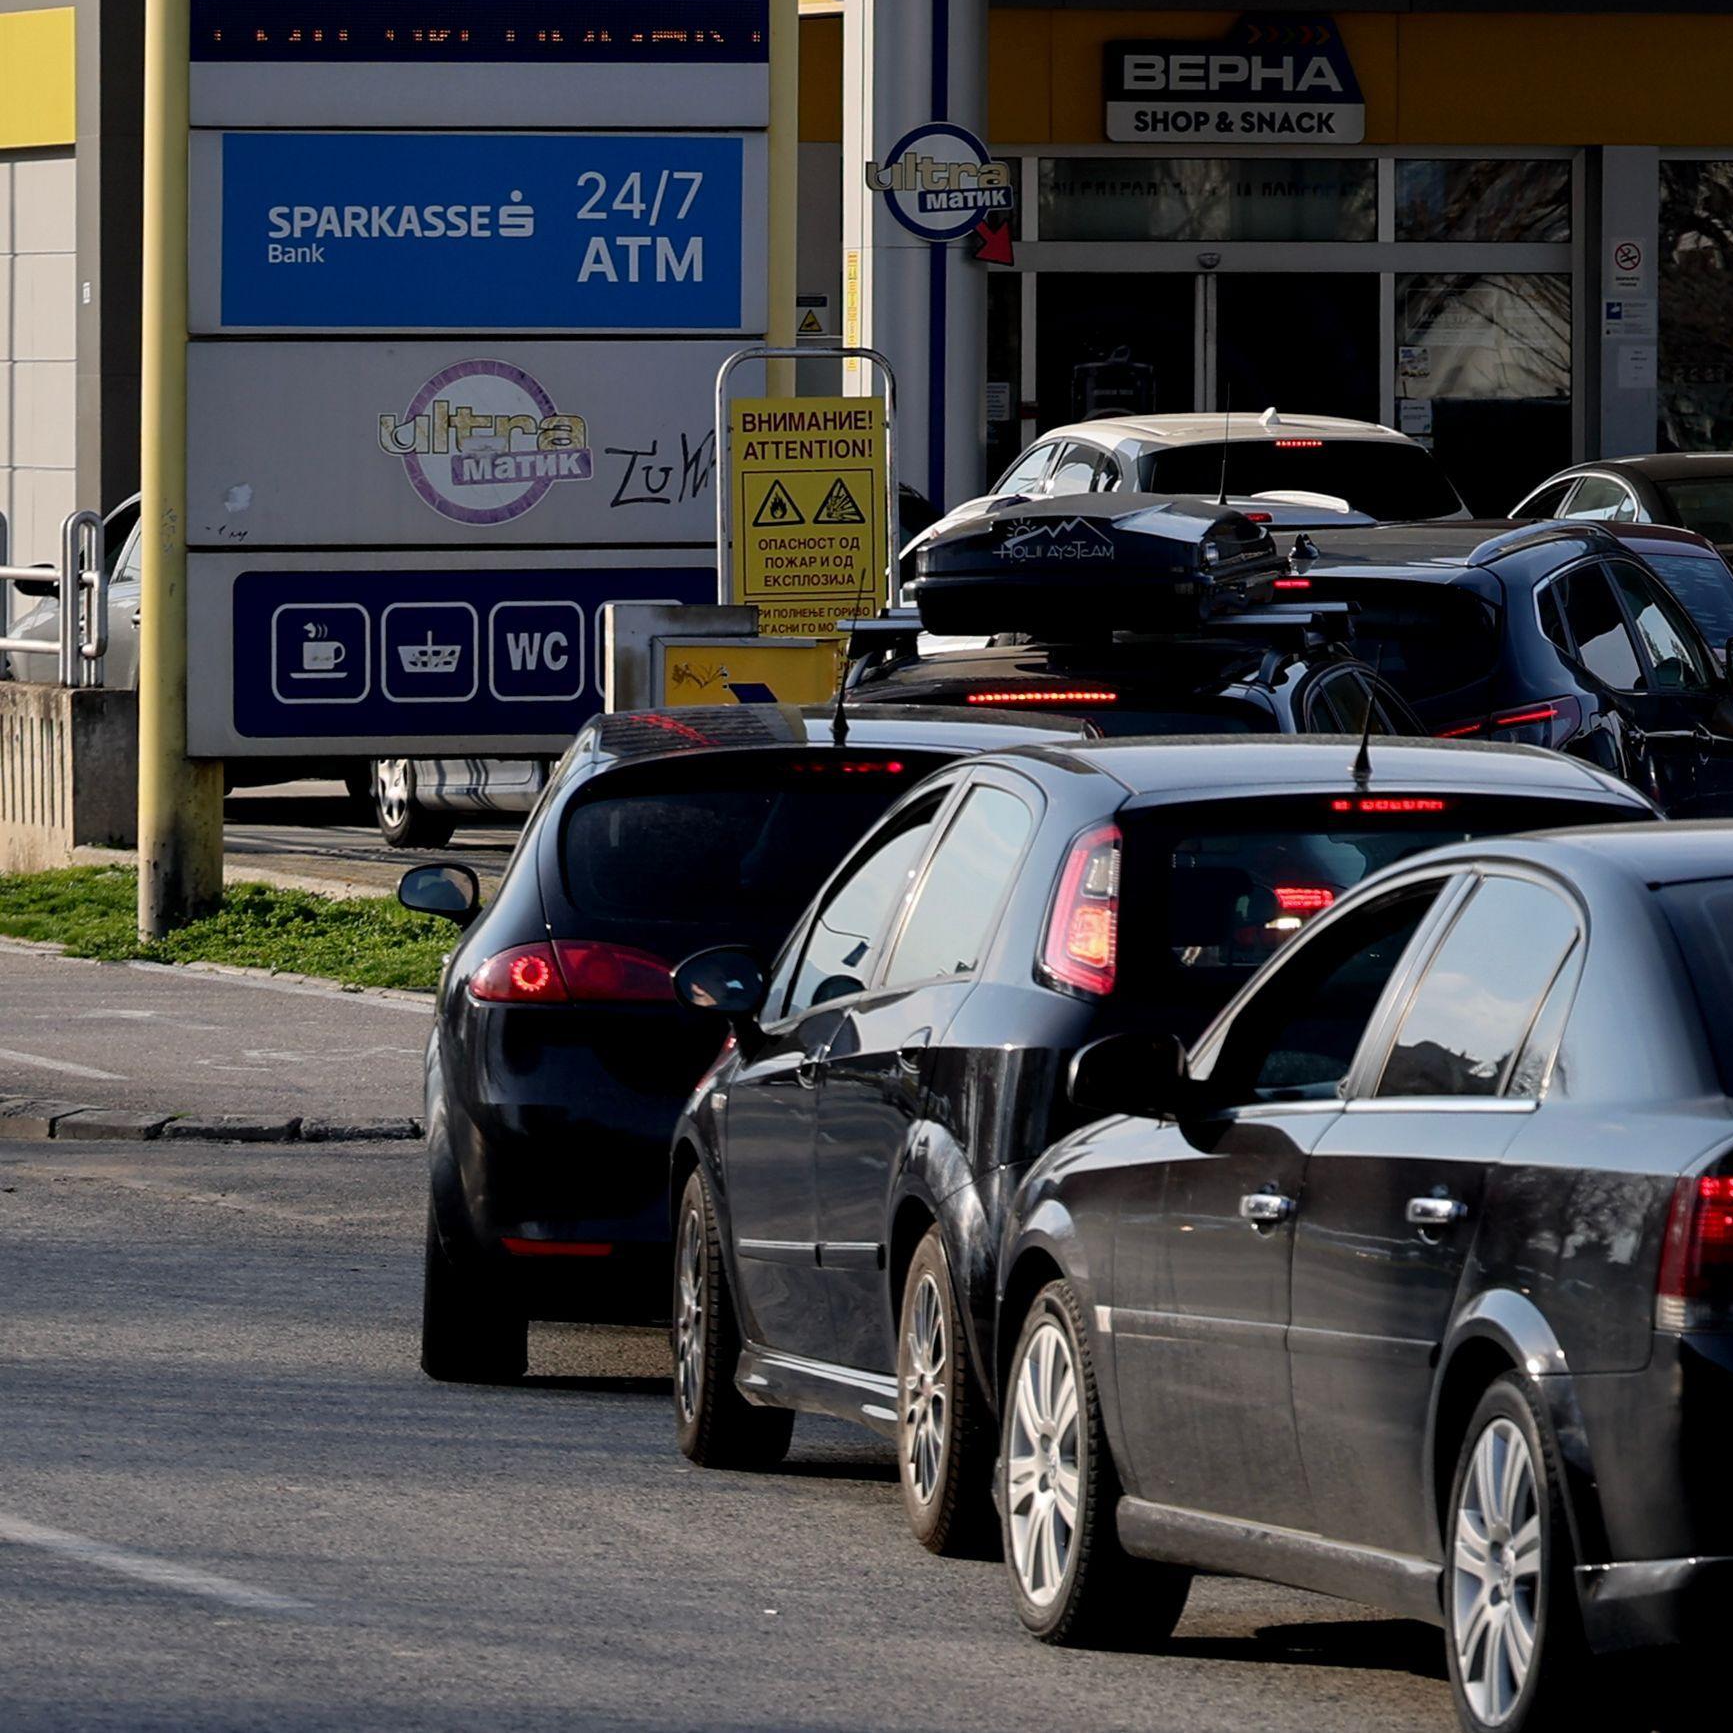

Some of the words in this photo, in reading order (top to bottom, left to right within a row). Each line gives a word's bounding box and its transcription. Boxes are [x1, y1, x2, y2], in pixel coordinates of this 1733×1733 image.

[1123, 53, 1344, 93] ВЕРНА
[1134, 110, 1209, 134] SHOP
[1215, 110, 1235, 134] &
[1240, 110, 1337, 135] SNACK
[866, 152, 1010, 192] ultra
[576, 169, 704, 222] 24/7
[267, 205, 491, 239] SPARKASSE
[267, 243, 325, 266] Bank
[577, 237, 704, 283] ATM
[377, 400, 589, 456] ultra
[742, 410, 873, 433] ВНИМАНИЕ!
[743, 438, 873, 461] ATTENTION!
[758, 537, 835, 551] ОПАСНОСТ
[839, 536, 860, 551] ОД
[765, 555, 817, 569] ПОЖАР
[821, 555, 830, 568] И
[833, 555, 854, 569] ОД
[764, 573, 855, 587] ЕКСПЛОЗИЈА
[758, 608, 772, 619] РИ
[773, 607, 825, 619] ПОЛНЕЊЕ
[828, 606, 870, 617] ГОРИВО
[758, 623, 798, 634] ЗГАСНИ
[801, 623, 816, 633] ГО
[506, 630, 568, 671] WC
